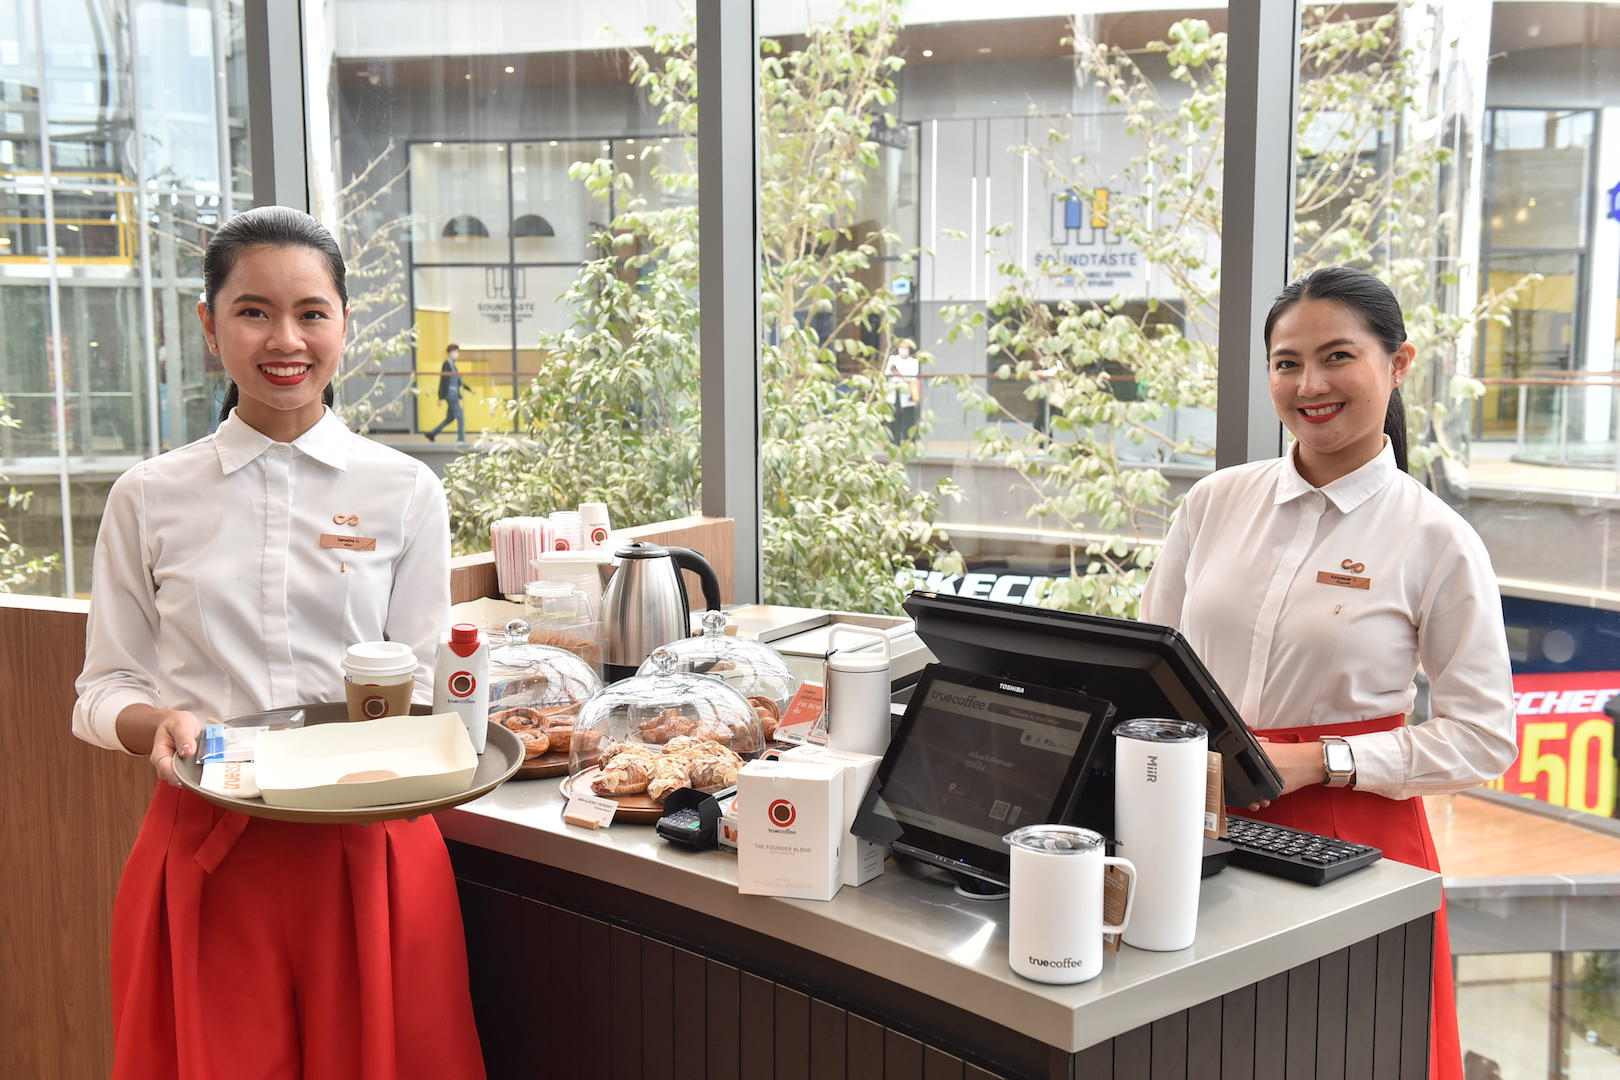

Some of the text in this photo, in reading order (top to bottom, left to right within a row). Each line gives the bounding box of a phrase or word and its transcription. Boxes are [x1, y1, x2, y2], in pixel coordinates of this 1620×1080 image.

[999, 683, 1025, 694] TOSHIBA
[932, 691, 986, 712] truecoffee
[223, 760, 241, 790] trueco
[1146, 755, 1158, 783] MiiR
[1519, 719, 1615, 818] 50
[1029, 955, 1083, 969] truecoffee
